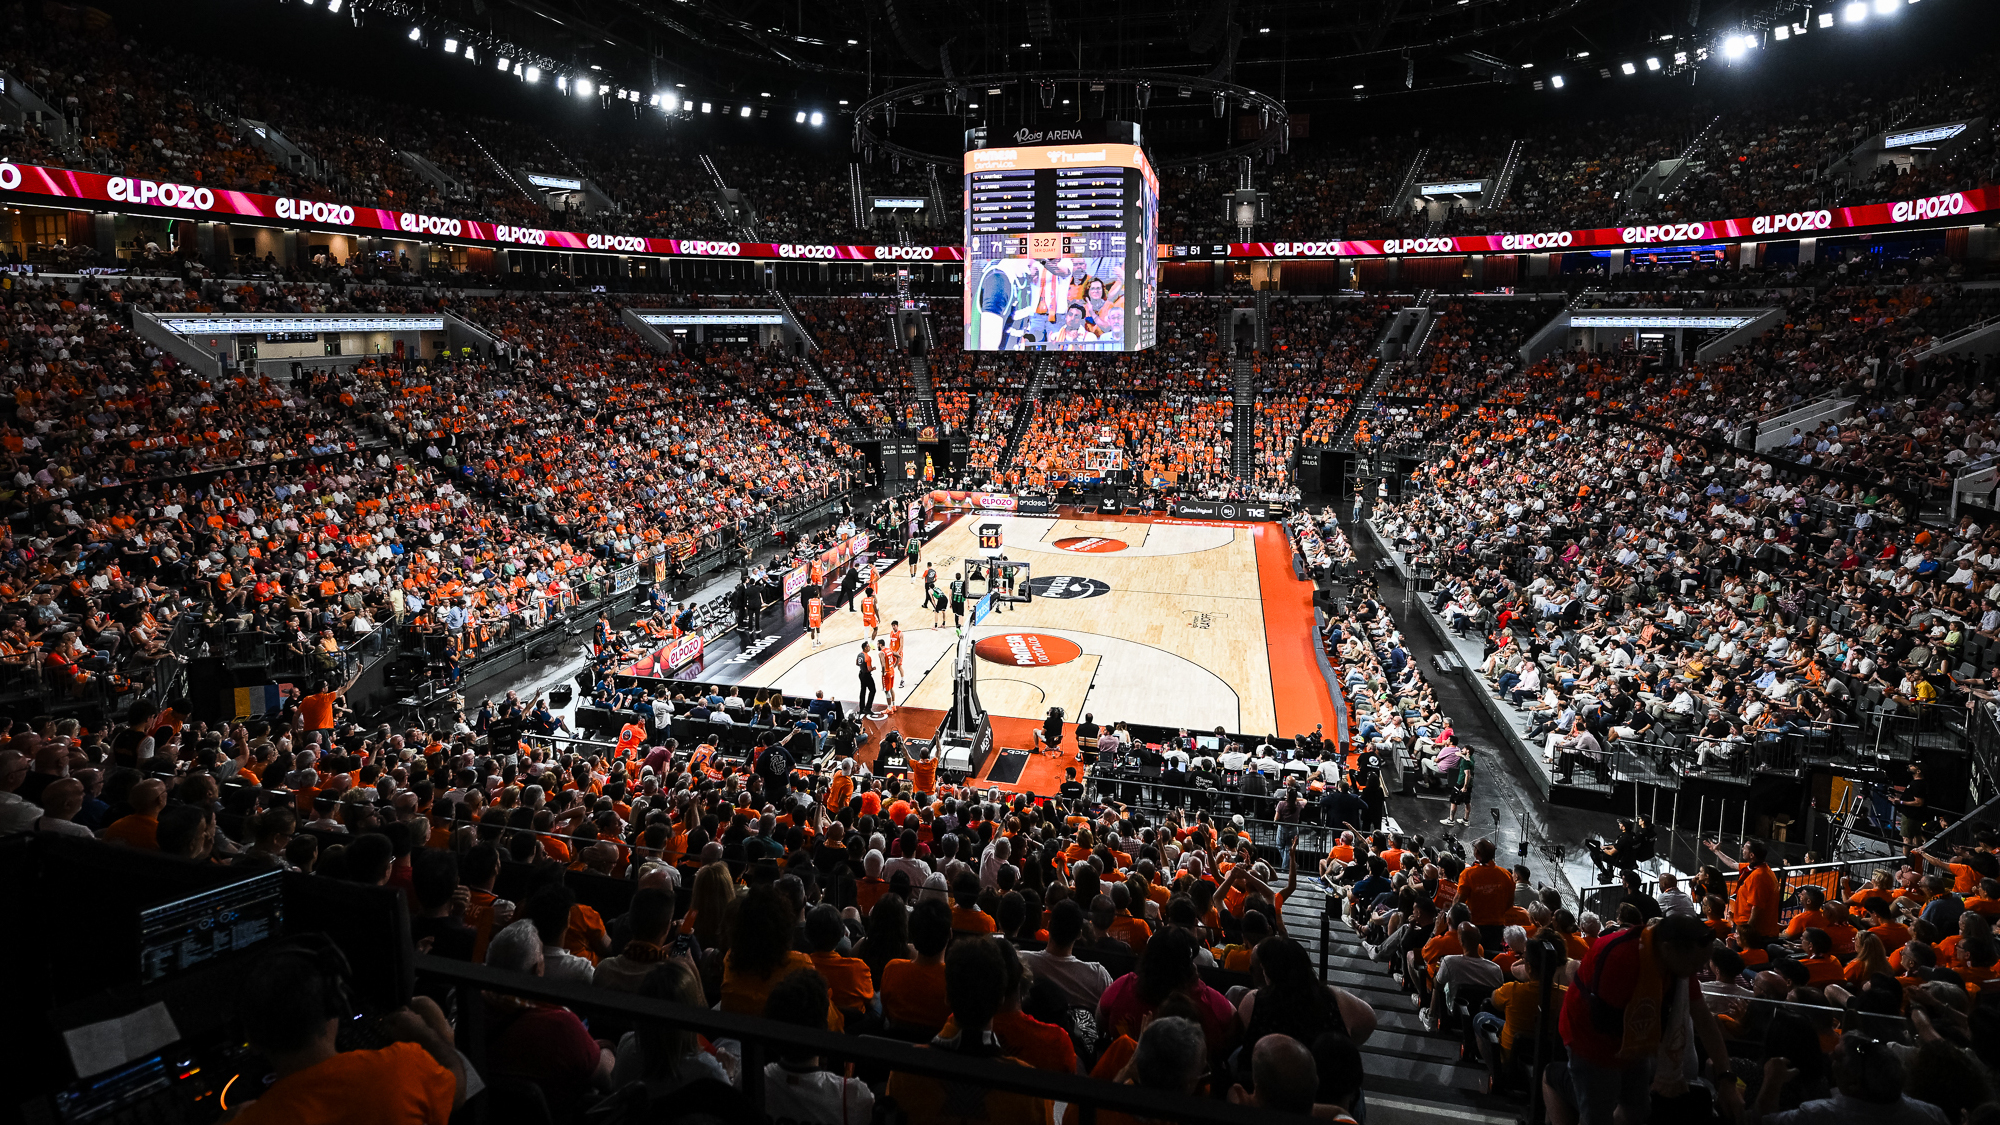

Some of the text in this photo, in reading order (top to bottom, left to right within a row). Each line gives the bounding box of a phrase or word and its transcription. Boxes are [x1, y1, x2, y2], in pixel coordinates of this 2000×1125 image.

[1046, 130, 1083, 141] ARENA
[1062, 149, 1106, 163] hummel
[991, 241, 1003, 252] 71
[1033, 238, 1057, 247] 3:27
[1088, 240, 1102, 251] 51
[1190, 245, 1201, 255] 51
[1046, 471, 1059, 480] 19
[1077, 472, 1091, 482] 86
[1019, 499, 1047, 507] endesa
[1246, 508, 1265, 518] TKE
[981, 536, 997, 548] 14
[812, 606, 818, 614] 0
